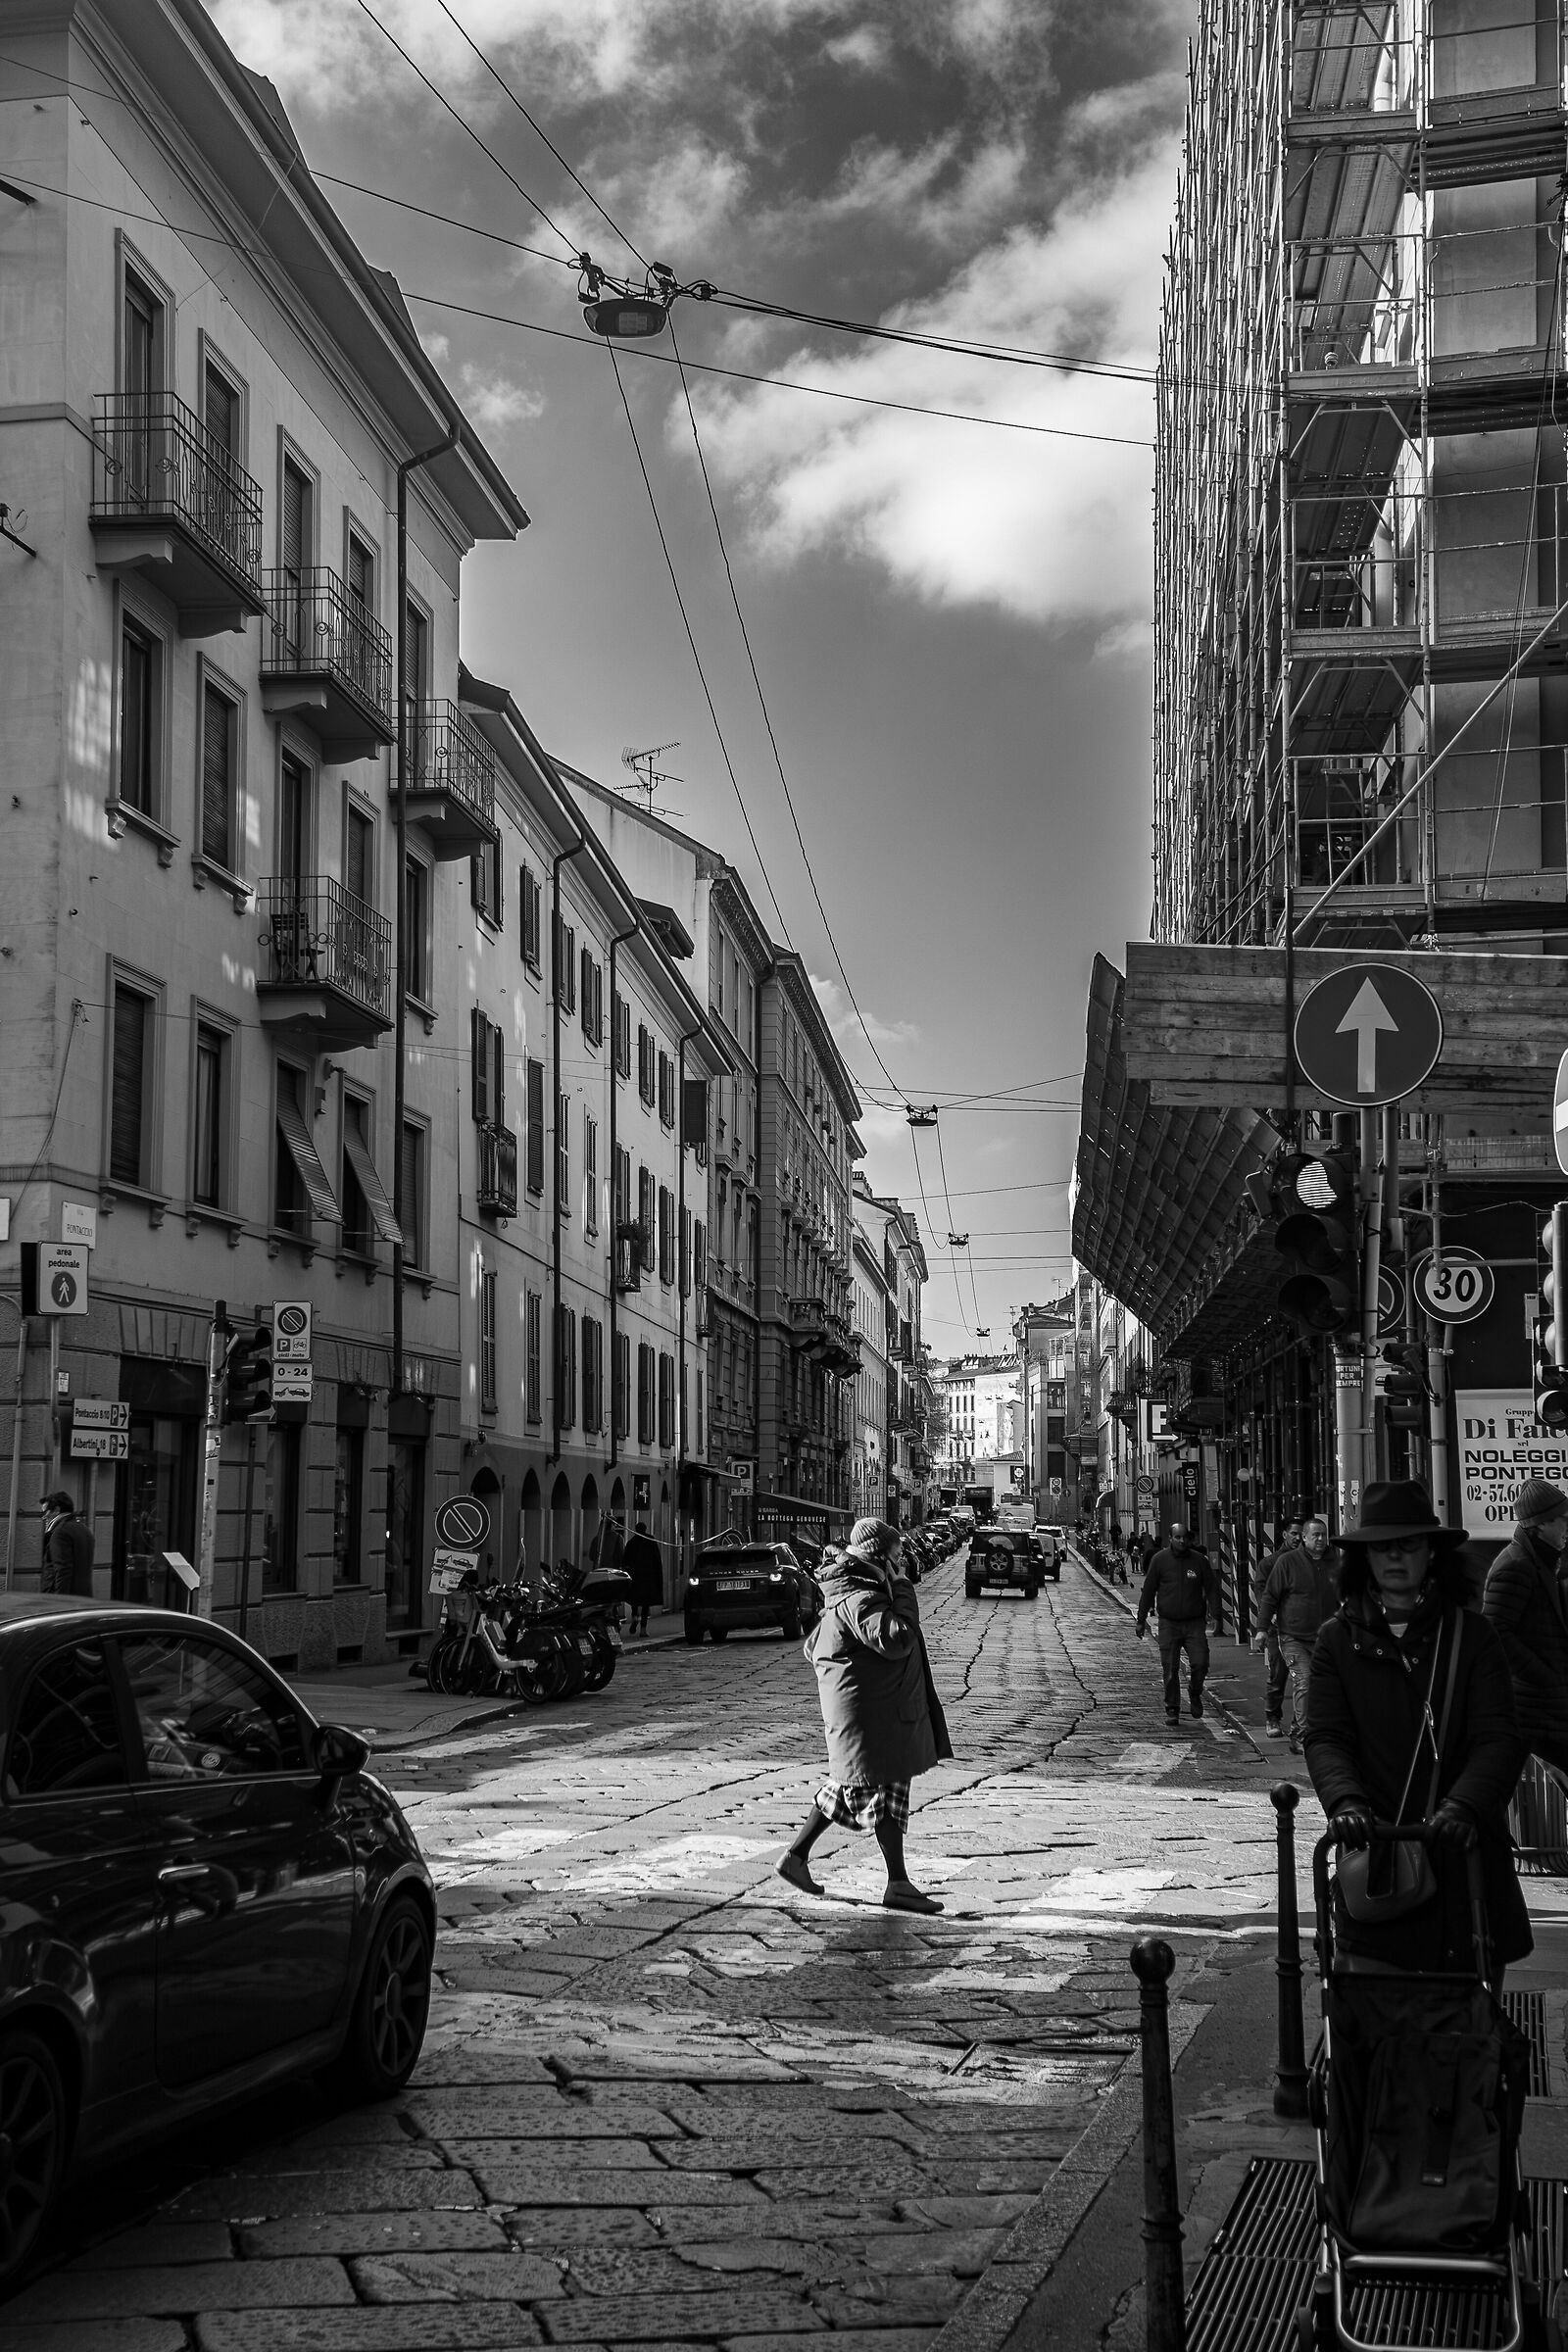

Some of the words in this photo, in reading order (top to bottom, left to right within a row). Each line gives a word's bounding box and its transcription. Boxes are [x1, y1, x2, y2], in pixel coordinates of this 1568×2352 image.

[48, 1259, 80, 1268] pedonale
[1433, 1267, 1476, 1302] 30
[279, 1340, 288, 1350] P
[294, 1367, 308, 1377] 24
[1505, 1408, 1535, 1417] Grupp
[1463, 1418, 1497, 1439] Di
[1505, 1418, 1568, 1439] Falc
[1184, 1468, 1197, 1496] cielo
